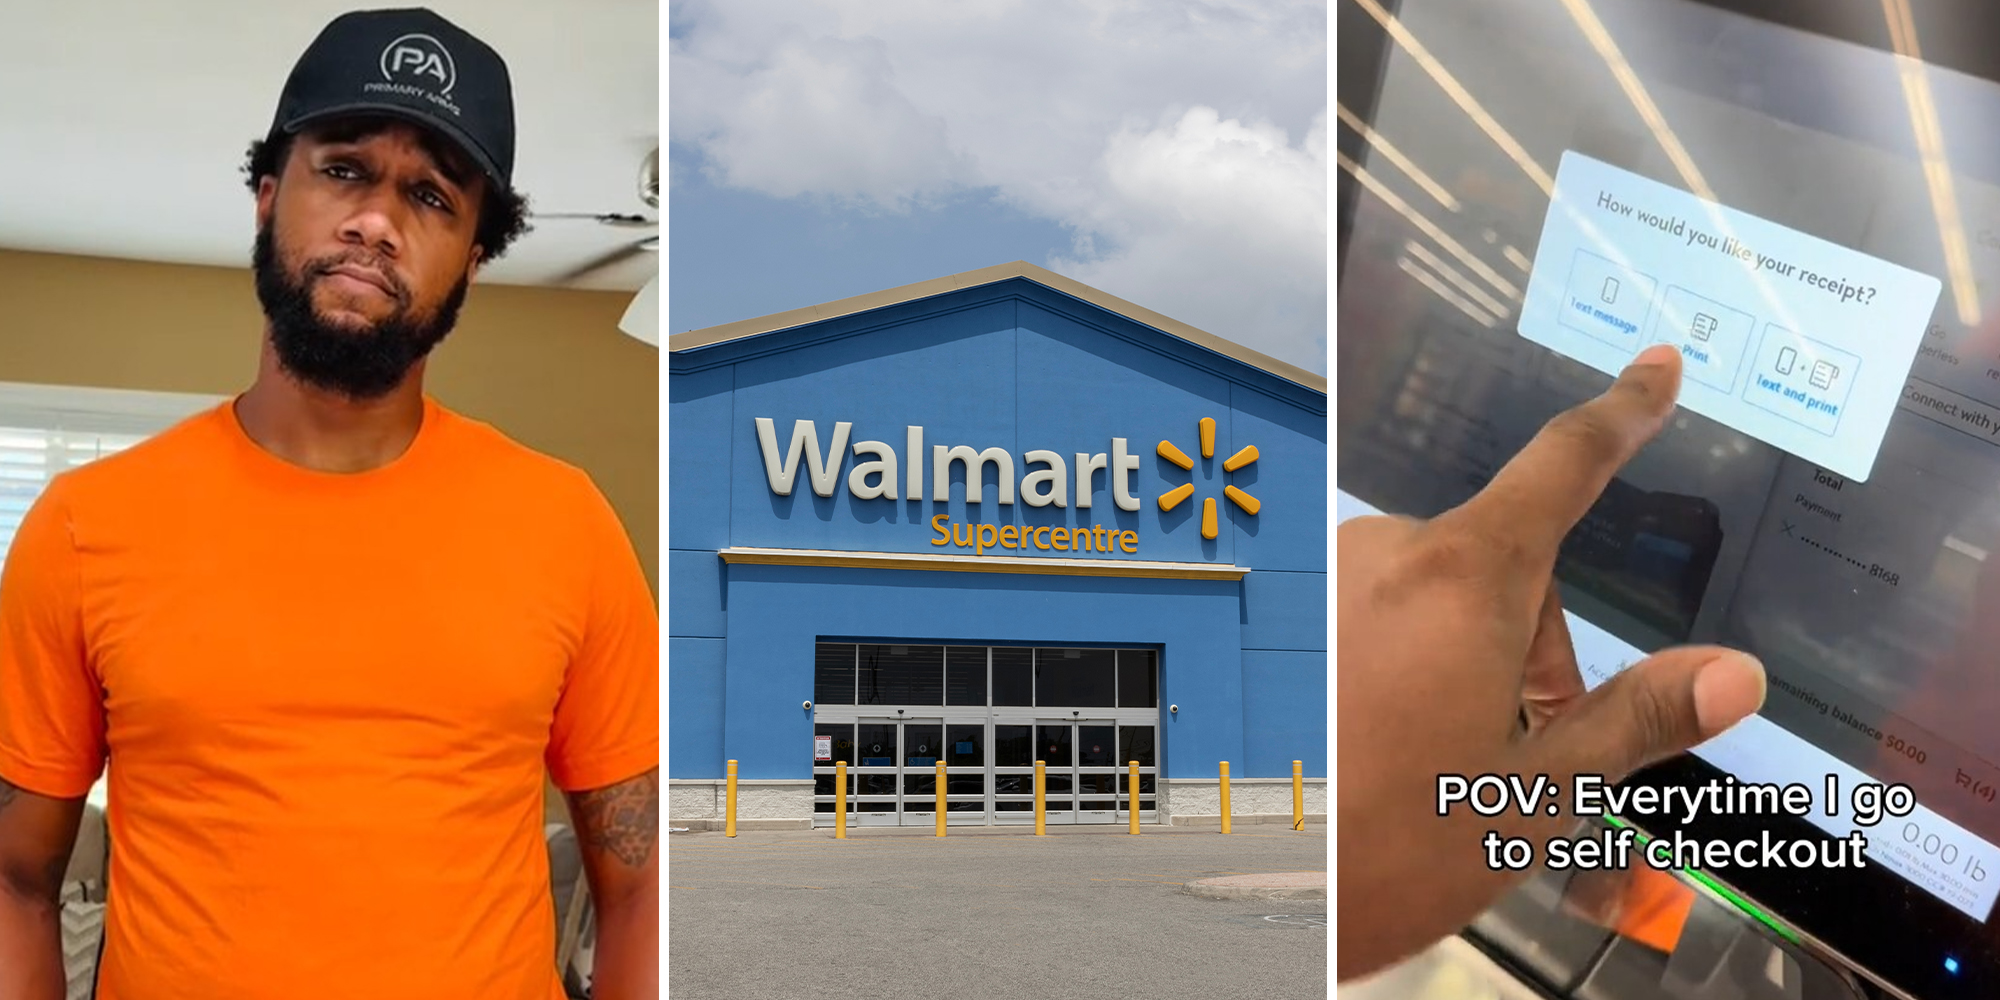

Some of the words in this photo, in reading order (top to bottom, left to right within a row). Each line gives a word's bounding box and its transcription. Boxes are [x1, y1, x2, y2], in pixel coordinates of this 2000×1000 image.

[392, 46, 447, 83] PA
[364, 82, 425, 97] PRIMARY
[1597, 190, 1633, 217] How
[1637, 210, 1687, 237] would
[1686, 228, 1719, 250] you
[1721, 236, 1752, 262] like
[1754, 253, 1796, 277] your
[1798, 269, 1877, 305] receipt?
[1570, 296, 1593, 315] Text
[1593, 308, 1638, 334] message
[1929, 324, 1946, 340] Go
[1682, 343, 1710, 364] Print
[1919, 343, 1959, 366] perless
[1757, 374, 1781, 393] Text
[1783, 387, 1807, 403] and
[1806, 396, 1839, 416] print
[1902, 384, 1958, 417] Connect
[1960, 410, 1990, 429] with
[755, 417, 1141, 513] Walmart
[1813, 468, 1844, 491] Total
[1795, 493, 1842, 522] Payment
[931, 513, 1139, 555] Supercentre
[1869, 563, 1900, 586] 8168
[1832, 706, 1882, 741] balance
[1886, 733, 1927, 765] $0.00
[1973, 781, 1997, 803] (4)
[1902, 822, 1959, 865] 0.00
[1963, 855, 1986, 882] lb
